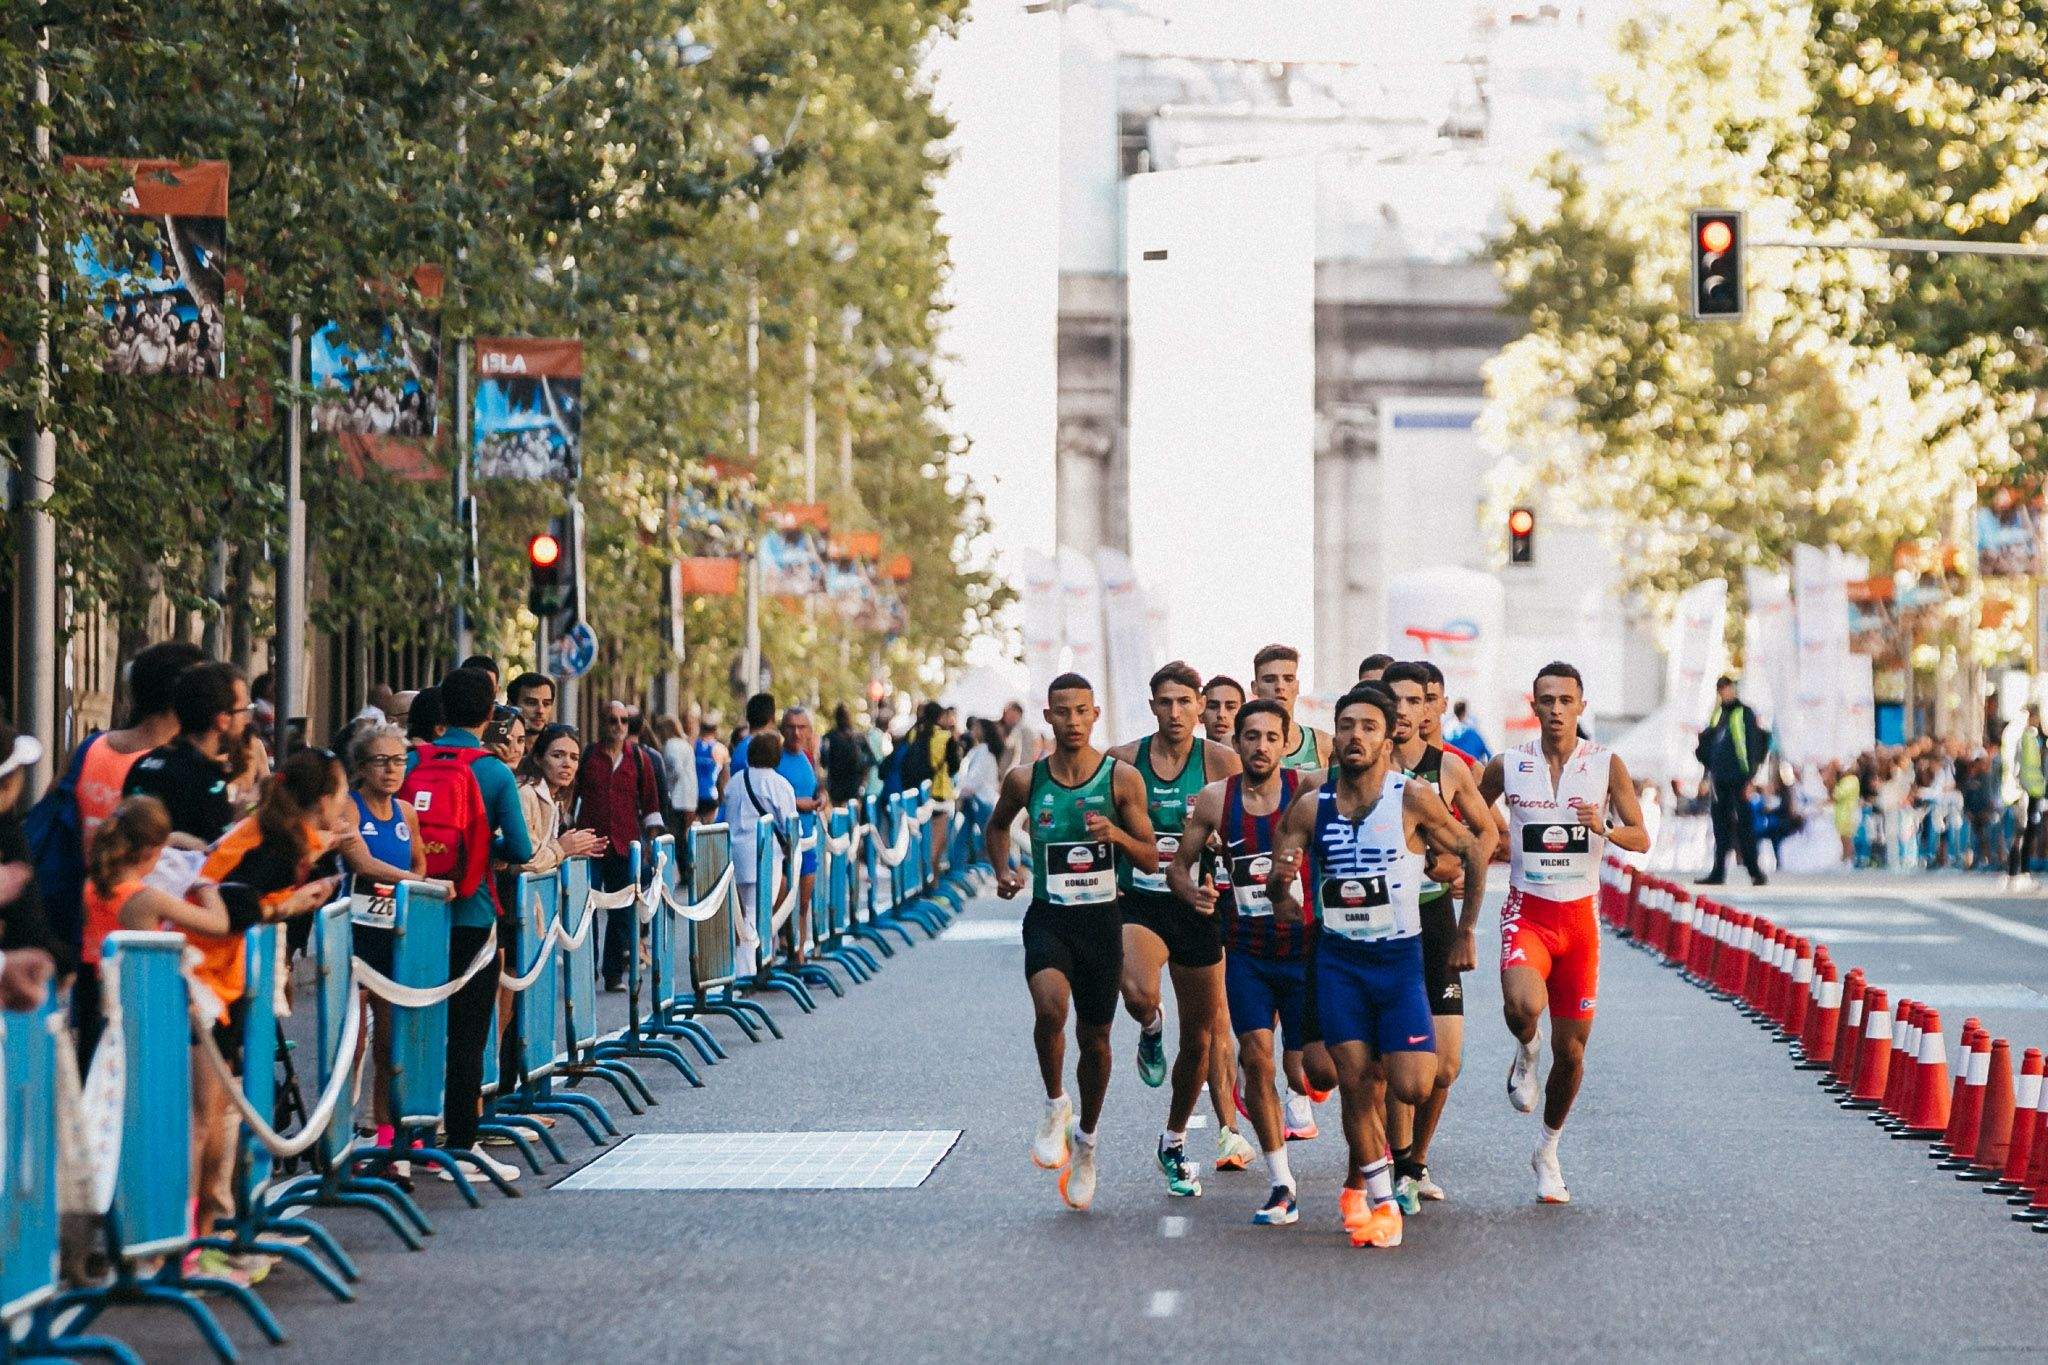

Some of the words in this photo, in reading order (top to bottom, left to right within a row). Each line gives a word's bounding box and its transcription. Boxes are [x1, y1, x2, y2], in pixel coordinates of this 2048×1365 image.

[482, 353, 526, 373] ISLA
[1509, 793, 1556, 809] Puerto
[1571, 826, 1585, 840] 12
[1098, 844, 1106, 858] 5
[1540, 858, 1570, 867] VILCHES
[1371, 878, 1380, 893] 1
